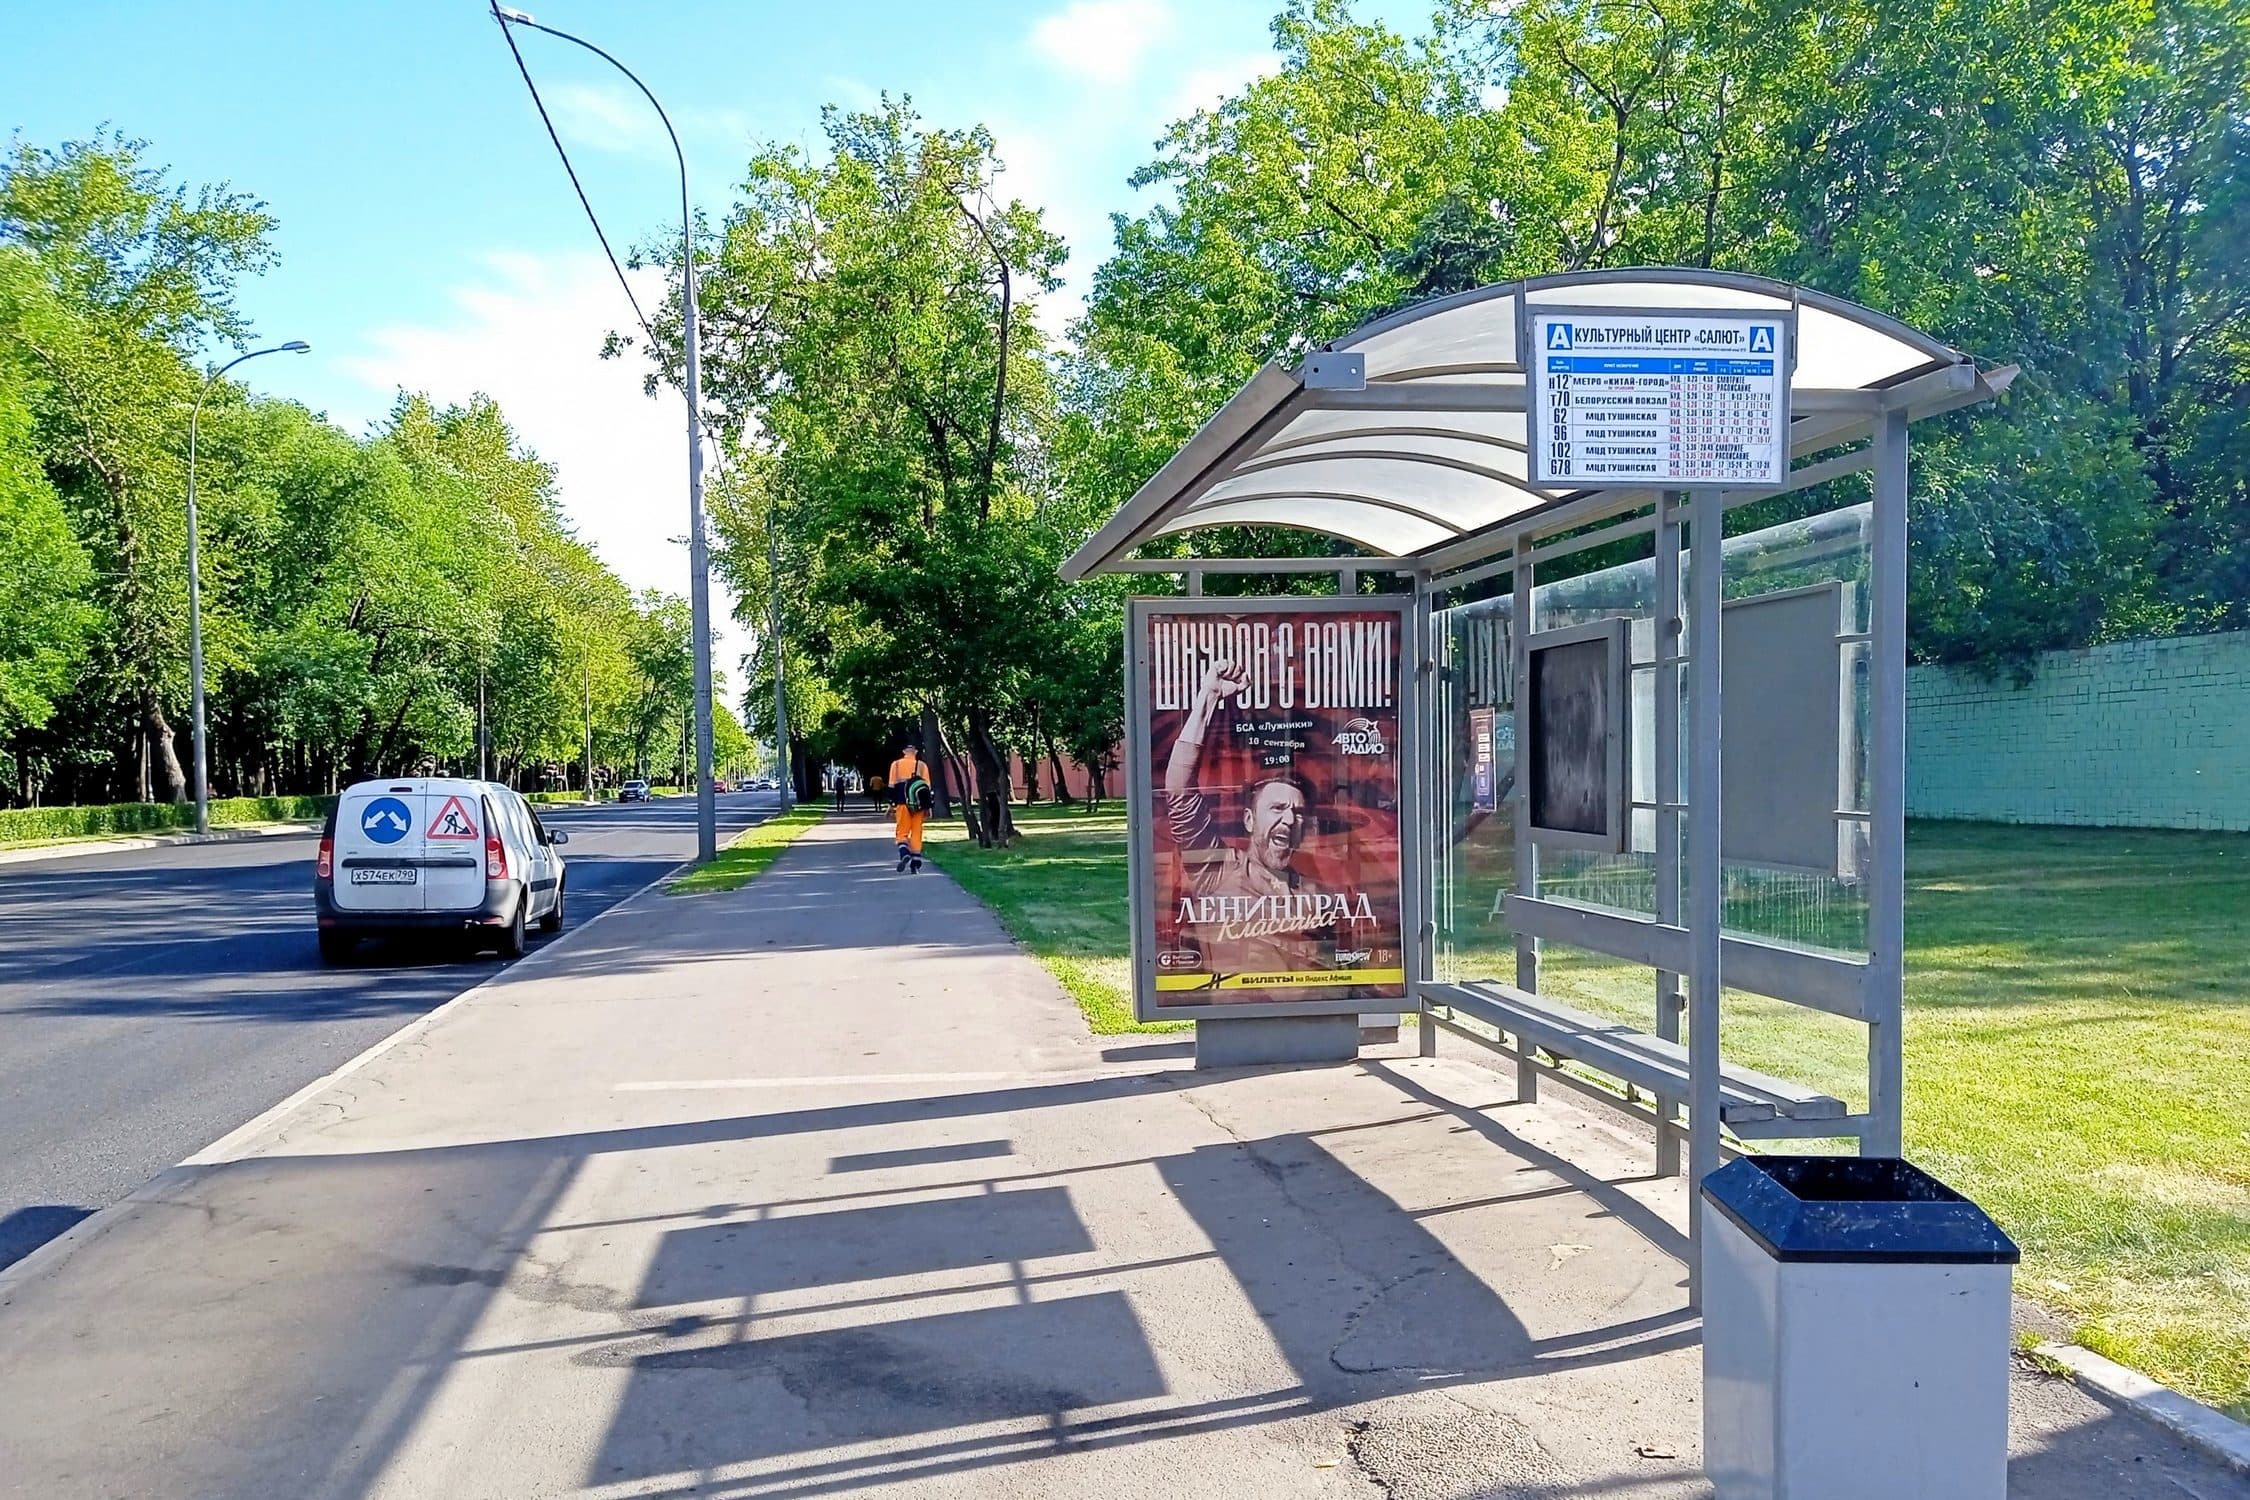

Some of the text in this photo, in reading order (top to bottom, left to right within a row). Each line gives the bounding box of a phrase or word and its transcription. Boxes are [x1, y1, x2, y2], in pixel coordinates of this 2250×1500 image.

[1550, 325, 1571, 349] А
[1575, 326, 1745, 345] КУЛЬТУРНЫЙ ЦЕНТР «САЛЮТ»
[1751, 328, 1772, 352] А
[1604, 377, 1669, 386] «КИТАЙ-ГОРОД»
[1575, 396, 1633, 404] БЕЛОРУССКИЙ
[1635, 397, 1667, 405] ВОКЗАЛ
[1554, 408, 1567, 424] 62
[1586, 412, 1657, 421] МЦД ТУШИНСКАЯ
[1554, 425, 1567, 440] 96
[1586, 430, 1657, 438] МЦД ТУШИНСКАЯ
[1551, 442, 1570, 458] 102
[1586, 447, 1657, 455] МЦД ТУШИНСКАЯ
[1551, 459, 1570, 475] 678
[1586, 464, 1657, 472] МЦД ТУШИНСКАЯ
[1154, 621, 1391, 710] ШНУРОВ С ВАМИ!
[1236, 719, 1313, 733] БСА «Лужники»
[1249, 737, 1305, 749] 10 сентября
[1332, 733, 1366, 745] АВТО
[1341, 743, 1385, 755] РАДИО
[1264, 755, 1290, 765] 19:00
[355, 870, 395, 881] Х574ЕК
[1175, 893, 1377, 927] ЛЕНИНГРАД
[1217, 910, 1337, 942] Классика
[1378, 949, 1392, 963] 18+
[1241, 976, 1294, 985] БИЛЕТЫ
[1305, 975, 1329, 984] Яндекс
